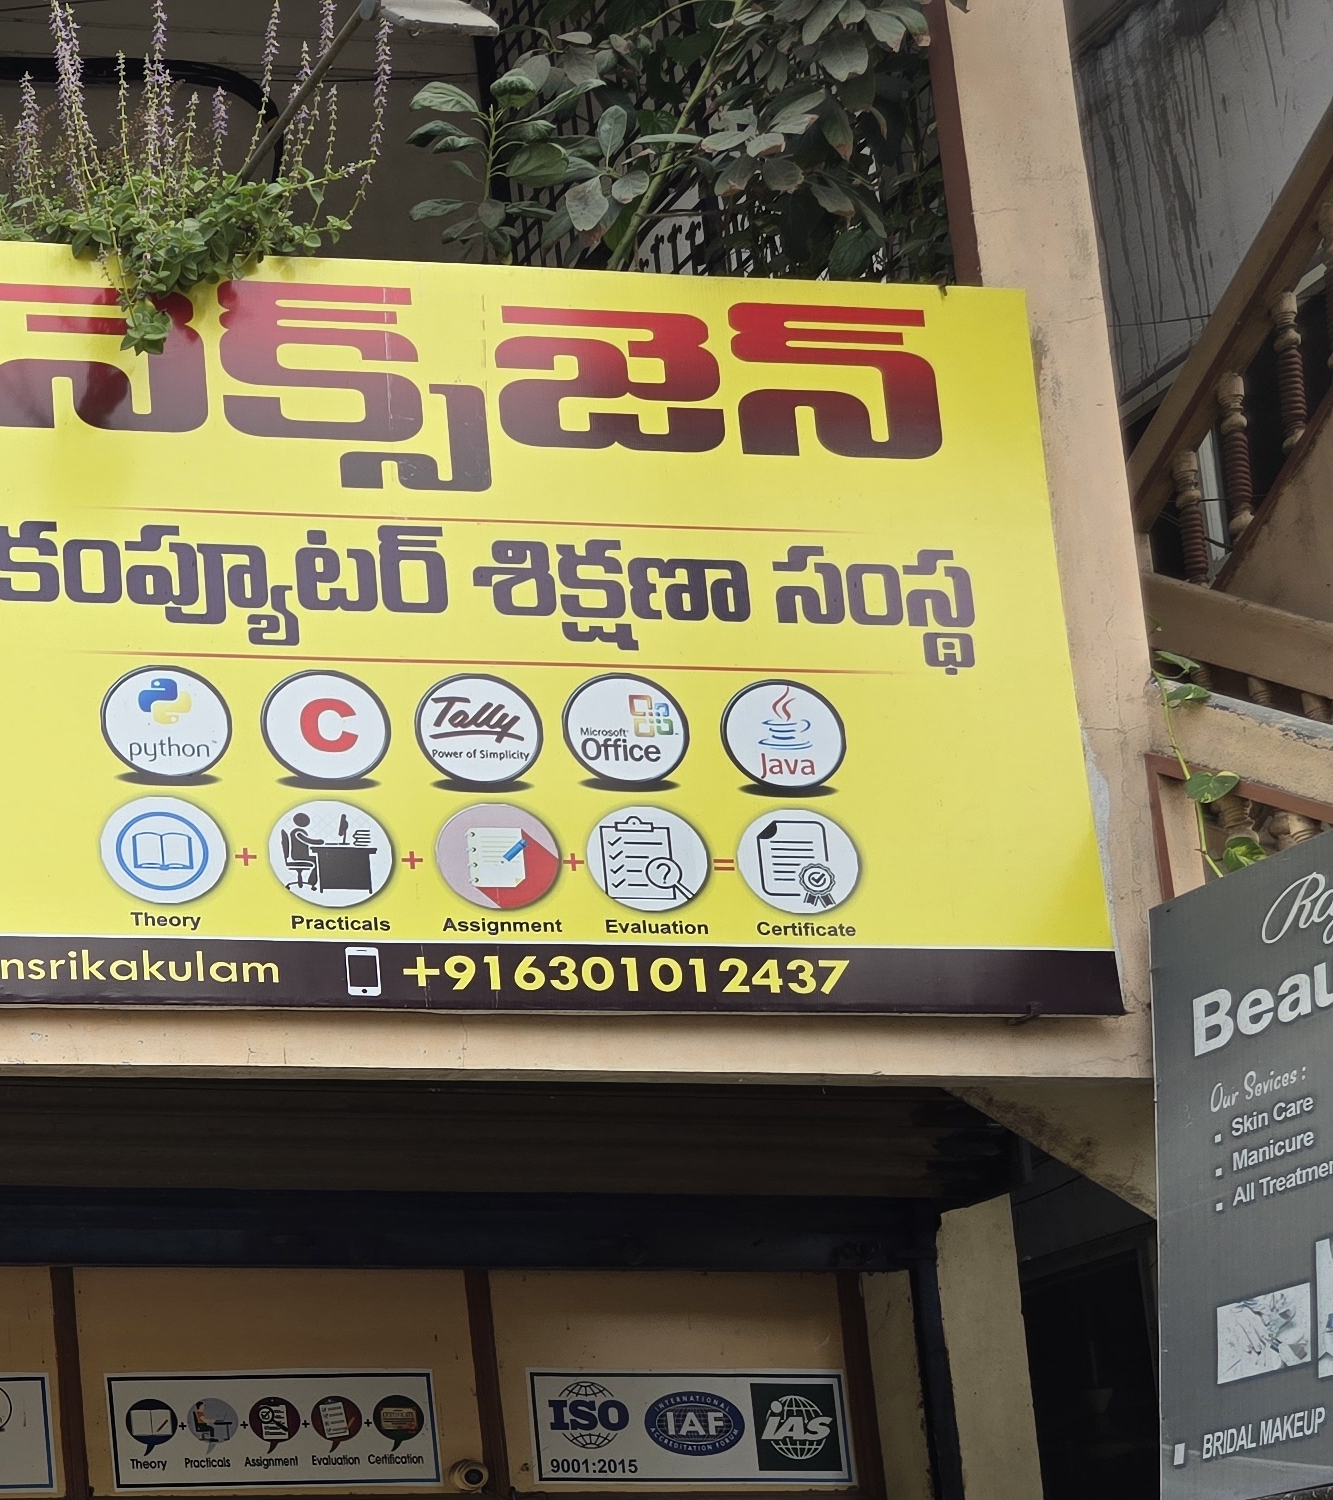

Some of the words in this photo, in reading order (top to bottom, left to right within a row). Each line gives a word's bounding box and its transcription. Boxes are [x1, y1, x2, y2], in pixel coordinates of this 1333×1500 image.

[473, 538, 750, 651] శిక్షణా
[774, 549, 976, 676] సంస్థ
[299, 697, 360, 754] C
[430, 696, 524, 743] Tally
[580, 728, 629, 737] Microsoft
[128, 734, 212, 762] python
[433, 749, 463, 759] Power
[466, 749, 477, 759] of
[480, 750, 530, 761] Simplicity
[581, 738, 661, 762] Office
[760, 751, 816, 777] Java
[131, 910, 201, 931] Theory
[290, 913, 391, 932] Practicals
[442, 916, 563, 937] Assignment
[605, 918, 709, 935] Evaluation
[756, 920, 856, 938] Certificate
[402, 951, 849, 998] +916301012437
[1232, 1112, 1268, 1136] Skin
[1273, 1097, 1313, 1121] Care
[1233, 1132, 1314, 1171] Manicure
[547, 1399, 629, 1432] ISO
[667, 1411, 724, 1435] IAF
[1203, 1422, 1256, 1460] BRIDAL
[1260, 1407, 1325, 1444] MAKEUP
[131, 1458, 167, 1471] Theory
[185, 1457, 231, 1468] Practicals
[244, 1455, 298, 1469] Assignment
[312, 1454, 360, 1466] Evaluation
[368, 1453, 423, 1466] Certification
[550, 1459, 638, 1474] 9001:2015
